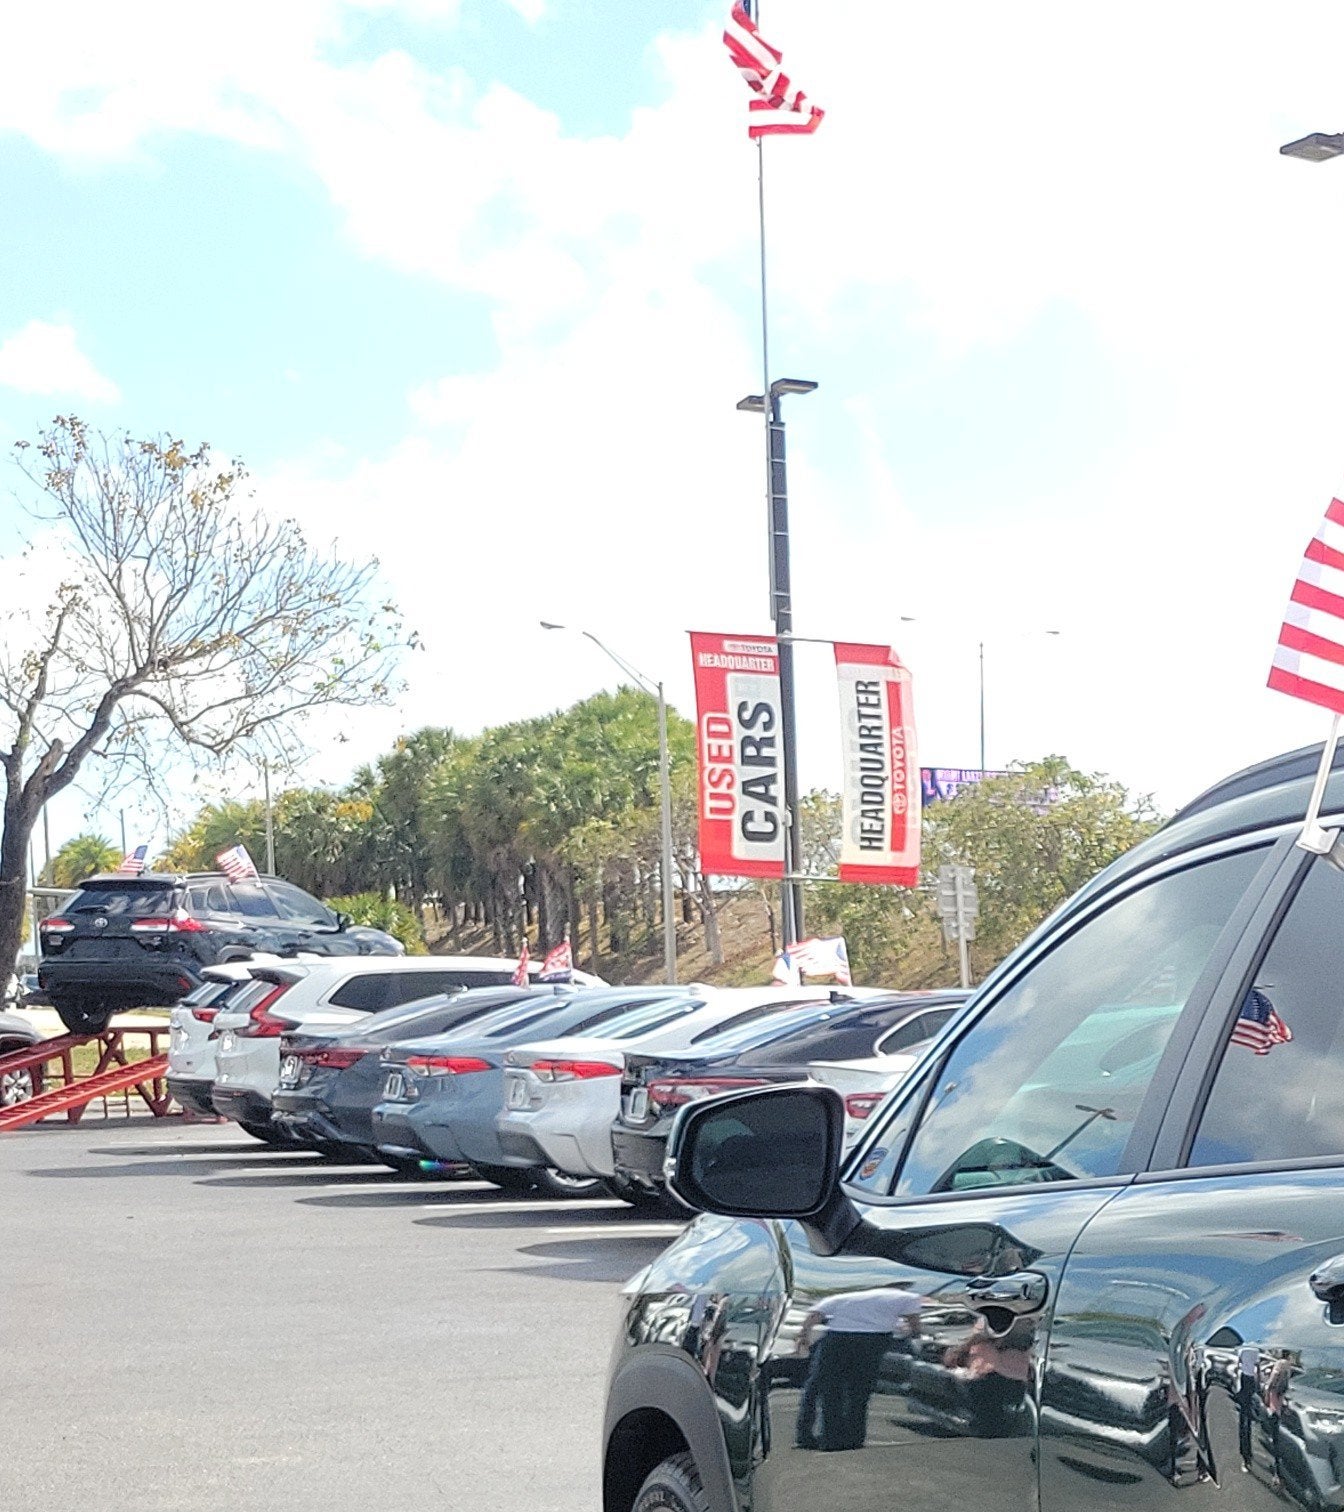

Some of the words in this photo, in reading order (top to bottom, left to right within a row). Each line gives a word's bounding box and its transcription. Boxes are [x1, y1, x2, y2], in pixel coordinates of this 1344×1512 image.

[698, 652, 775, 671] HEADQUARTER
[705, 713, 736, 818] USED
[738, 701, 780, 842] CARS
[855, 680, 889, 851] HEADQUARTER
[891, 726, 907, 790] TOYOTA
